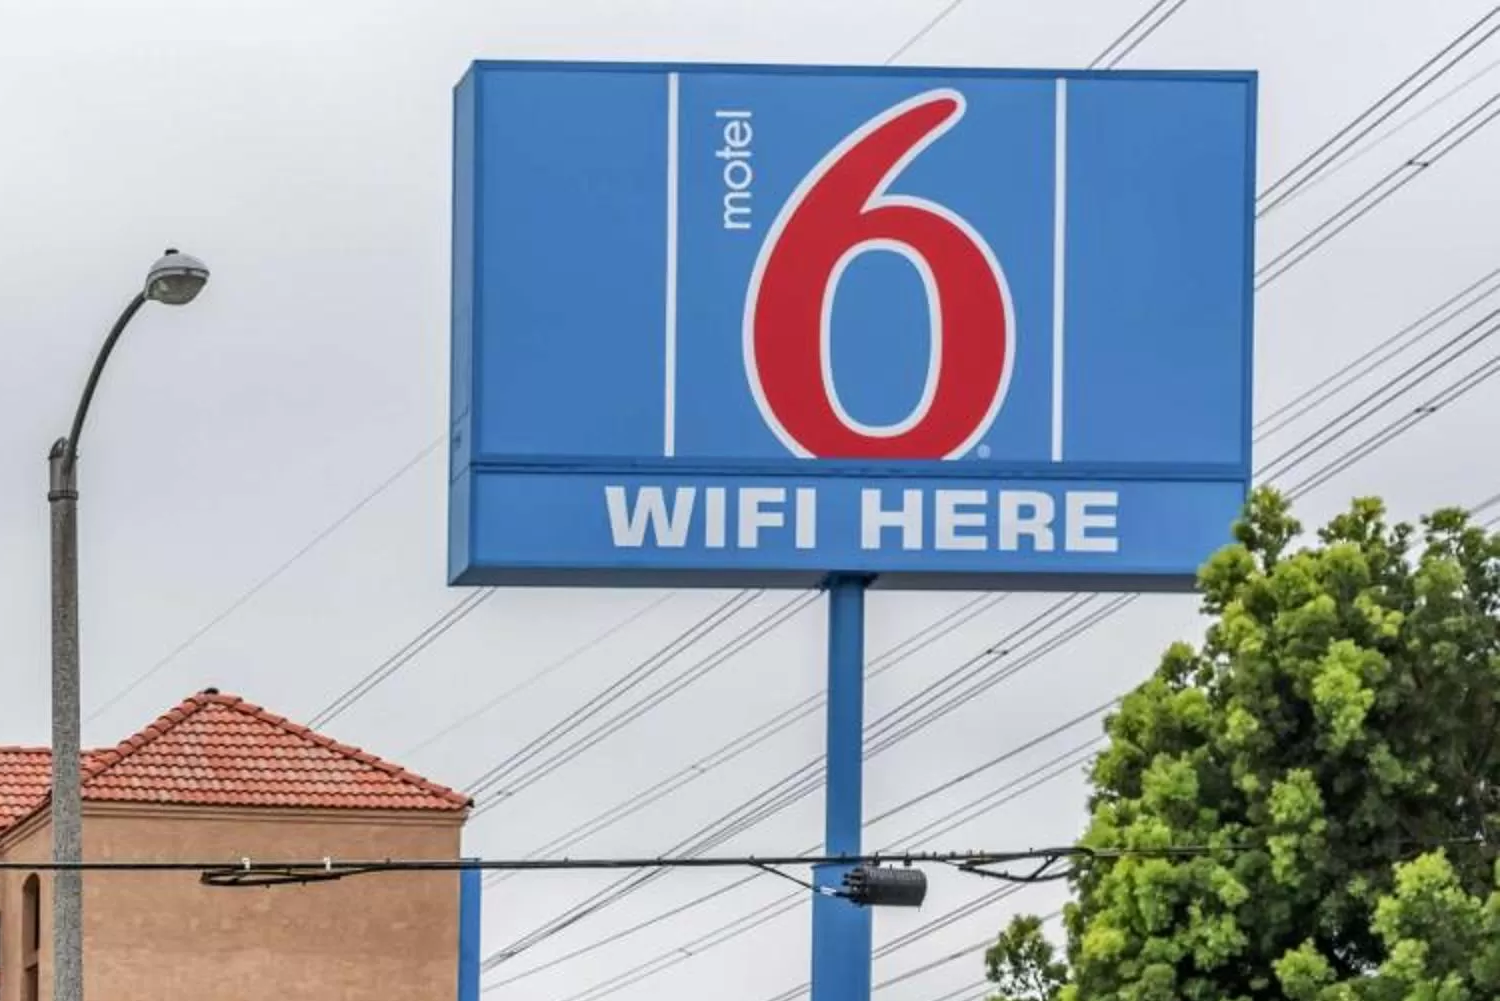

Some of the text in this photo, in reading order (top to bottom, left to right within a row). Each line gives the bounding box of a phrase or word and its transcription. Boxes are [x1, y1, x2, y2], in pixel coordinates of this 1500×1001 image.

[715, 88, 1016, 459] motel 6
[606, 486, 1119, 552] WIFI HERE
